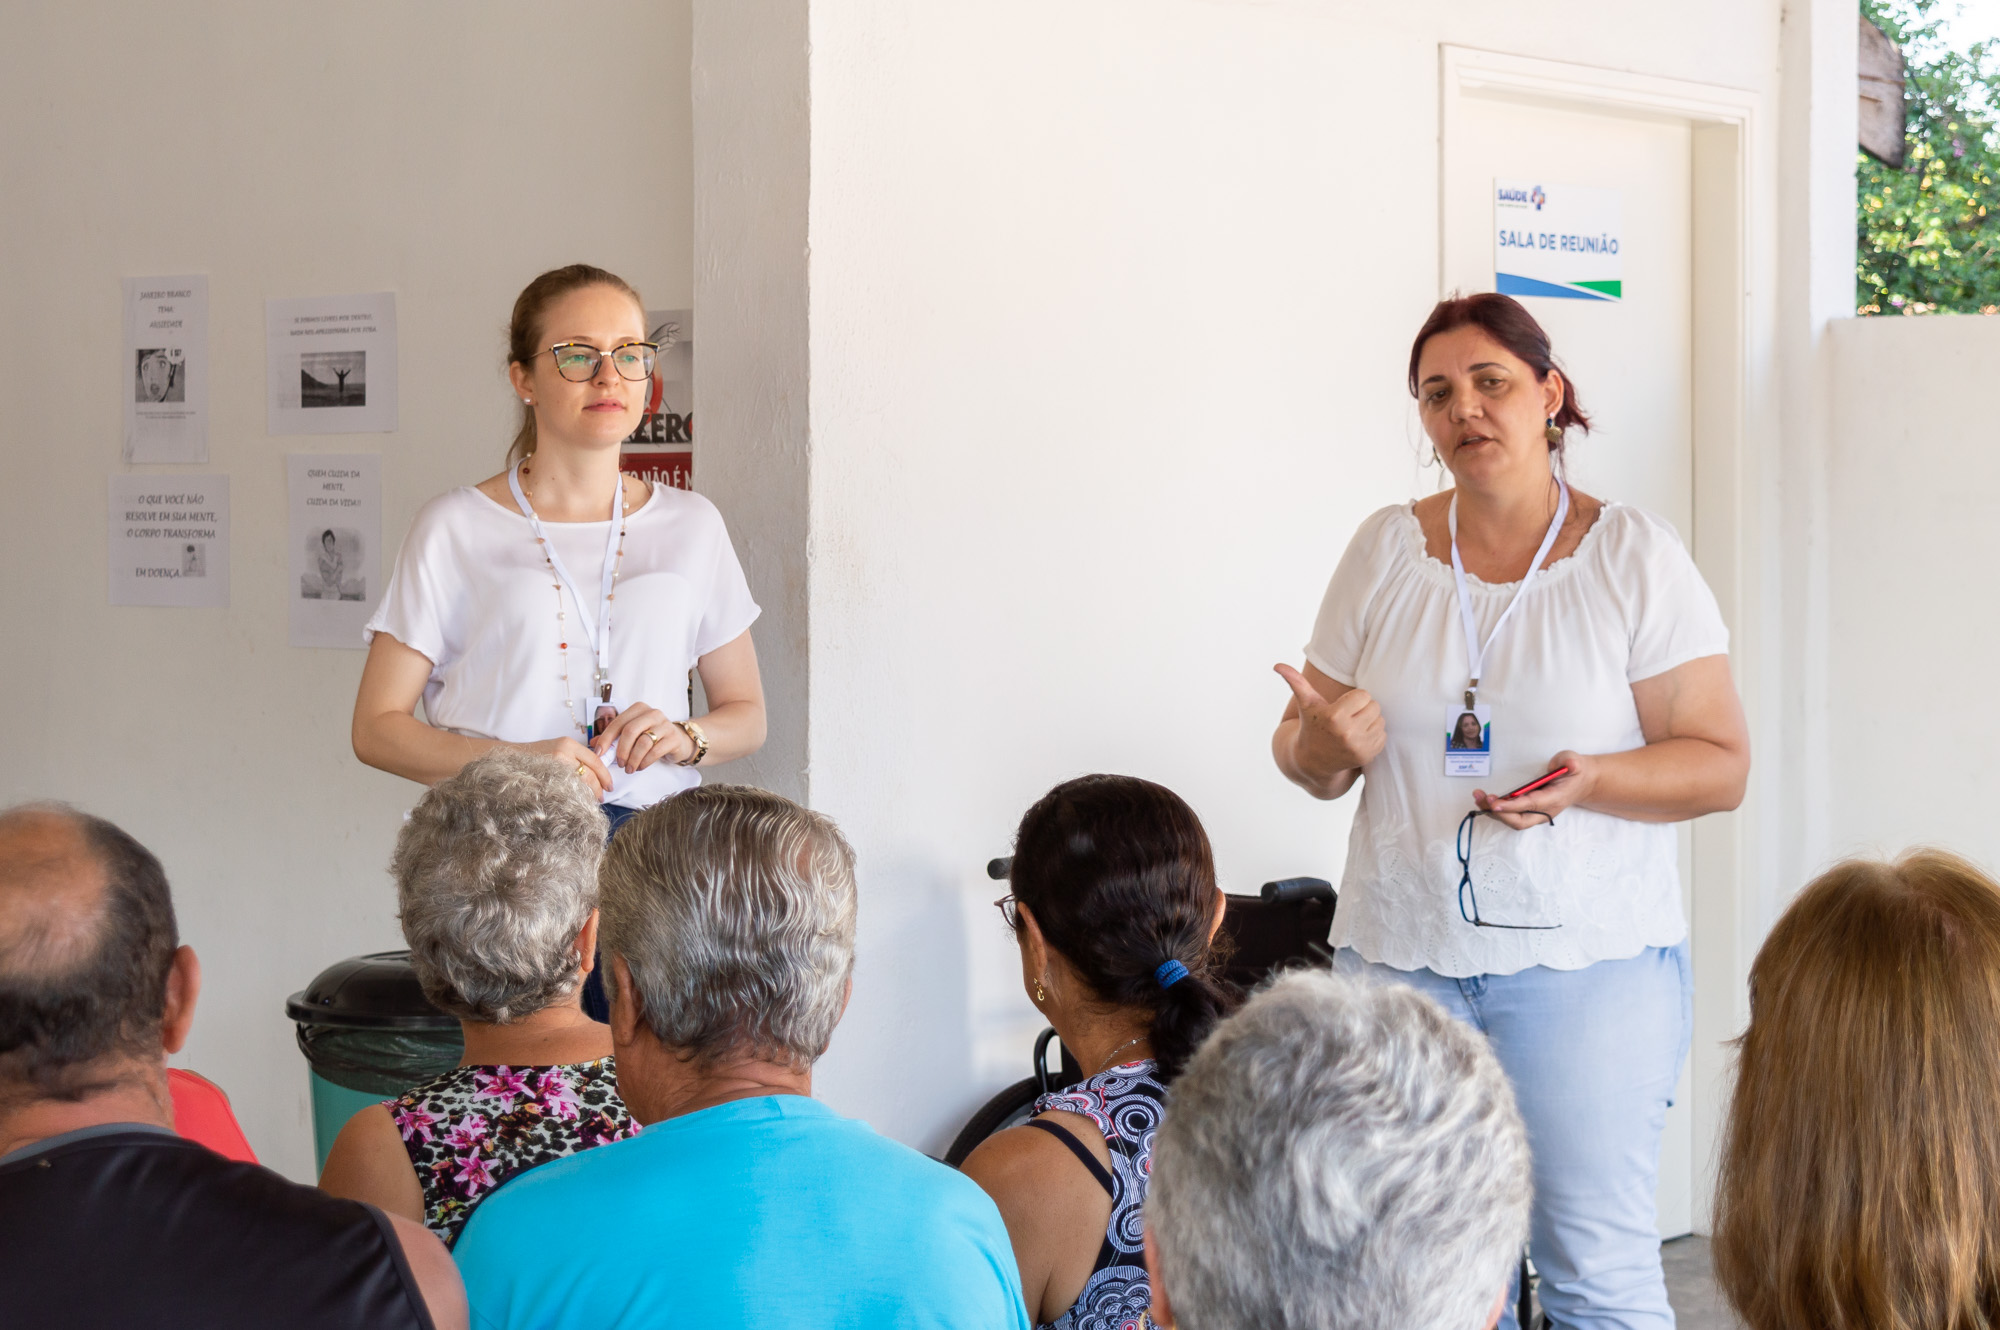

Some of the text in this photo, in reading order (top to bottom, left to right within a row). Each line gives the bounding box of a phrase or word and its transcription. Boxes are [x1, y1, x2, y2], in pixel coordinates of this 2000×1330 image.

[1499, 229, 1618, 254] SALA DE REUNIÃO
[167, 290, 191, 298] BRANCO
[308, 469, 360, 478] QUEM CUIDA DA
[138, 493, 204, 506] O QUE VOCÊ NÃO
[306, 498, 327, 506] CUIDA
[329, 498, 339, 506] DA
[126, 511, 217, 522] RESOLVE EM SUA MENTE,
[127, 529, 216, 539] O CORPO TRANSFORMA
[136, 567, 146, 578] EM
